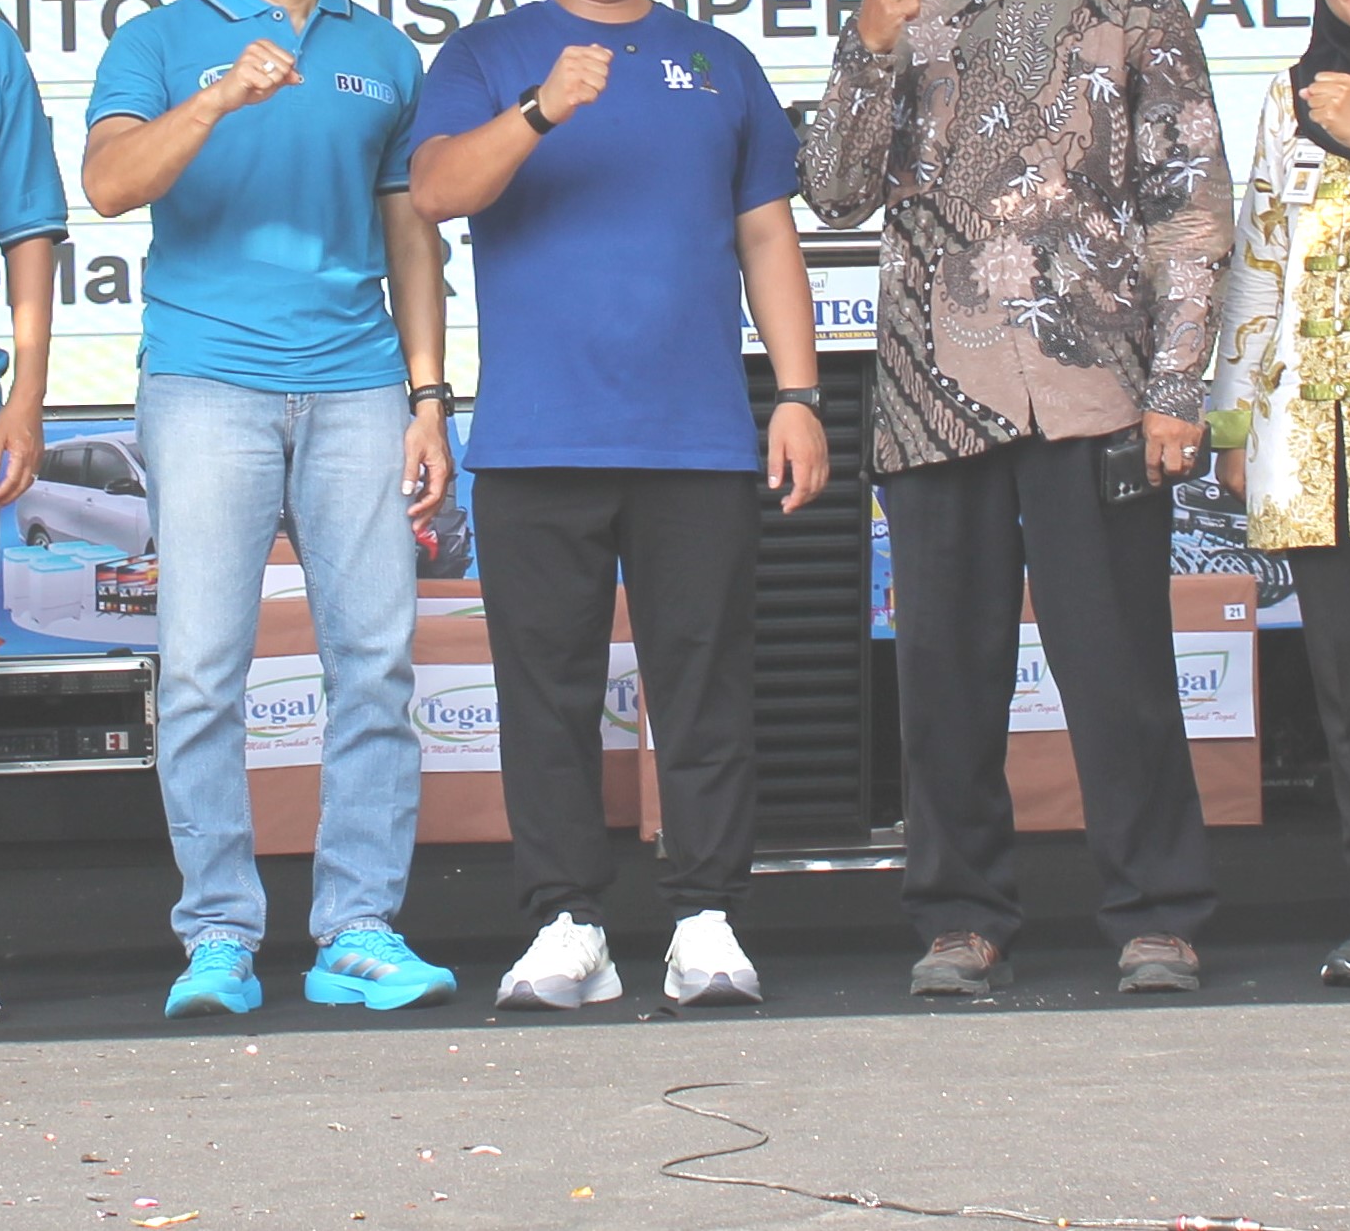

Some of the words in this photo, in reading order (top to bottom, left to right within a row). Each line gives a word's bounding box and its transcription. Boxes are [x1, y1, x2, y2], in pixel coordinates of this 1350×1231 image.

[660, 59, 694, 89] LA
[813, 298, 876, 326] TEG
[1229, 607, 1242, 618] 21
[1177, 669, 1218, 697] gal
[247, 693, 317, 724] egal
